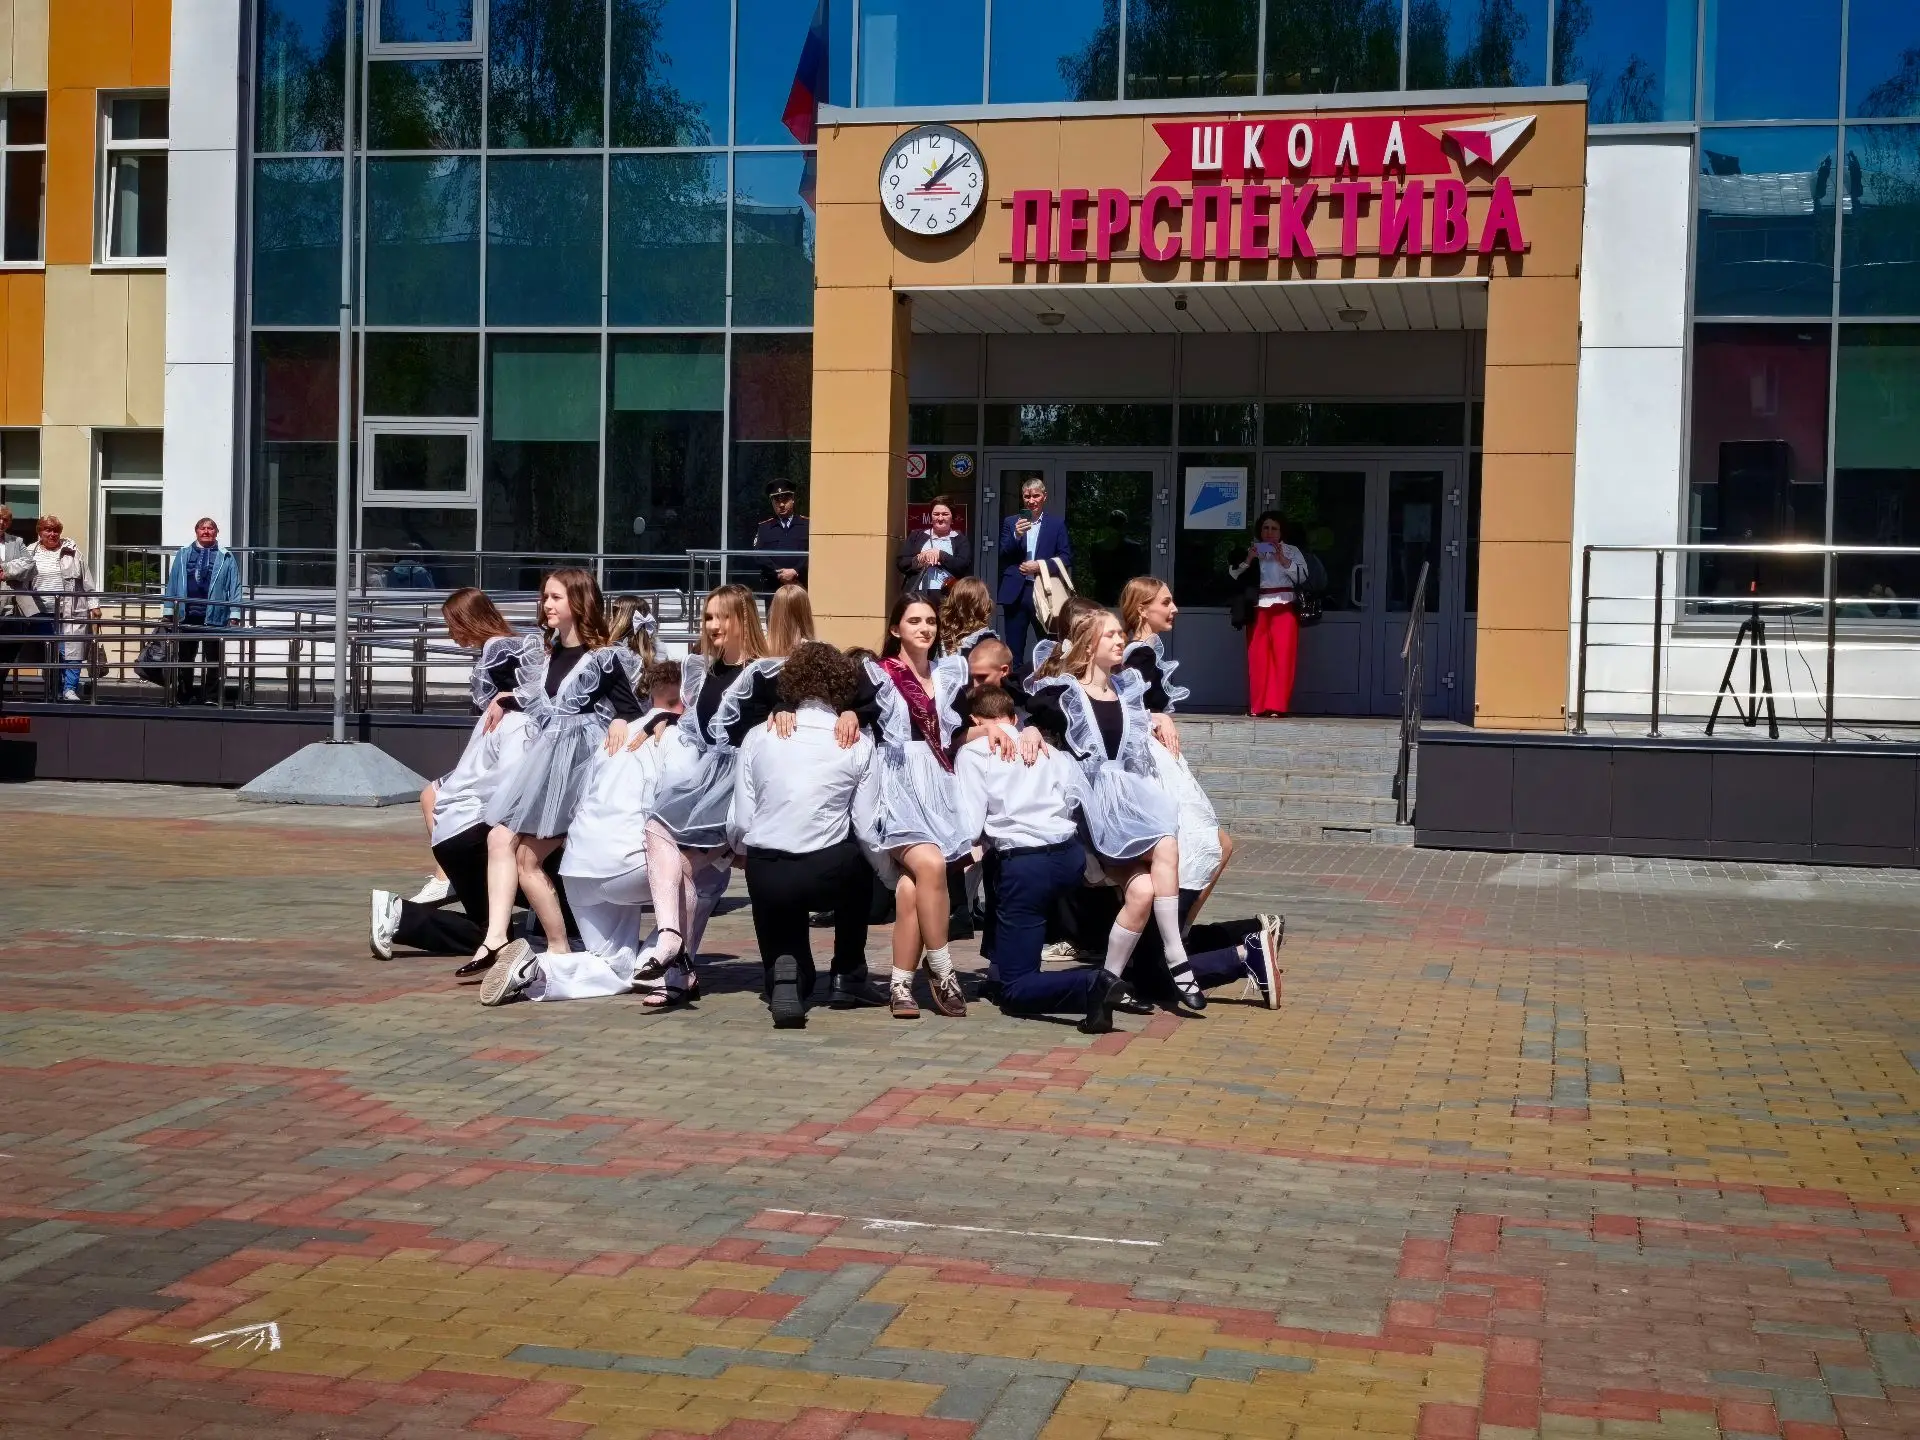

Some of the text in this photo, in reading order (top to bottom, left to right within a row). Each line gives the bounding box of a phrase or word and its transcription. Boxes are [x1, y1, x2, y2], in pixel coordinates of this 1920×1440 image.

[911, 139, 920, 155] 11
[929, 133, 941, 149] 12
[1192, 120, 1407, 170] ШКОЛА
[895, 153, 909, 169] 10
[962, 152, 972, 168] 2
[889, 174, 900, 190] 9
[968, 172, 977, 188] 3
[895, 194, 904, 210] 8
[961, 193, 971, 208] 4
[910, 209, 921, 224] 7
[927, 214, 938, 229] 6
[946, 208, 956, 223] 5
[1011, 175, 1524, 262] ПЕРСПЕКТИВА
